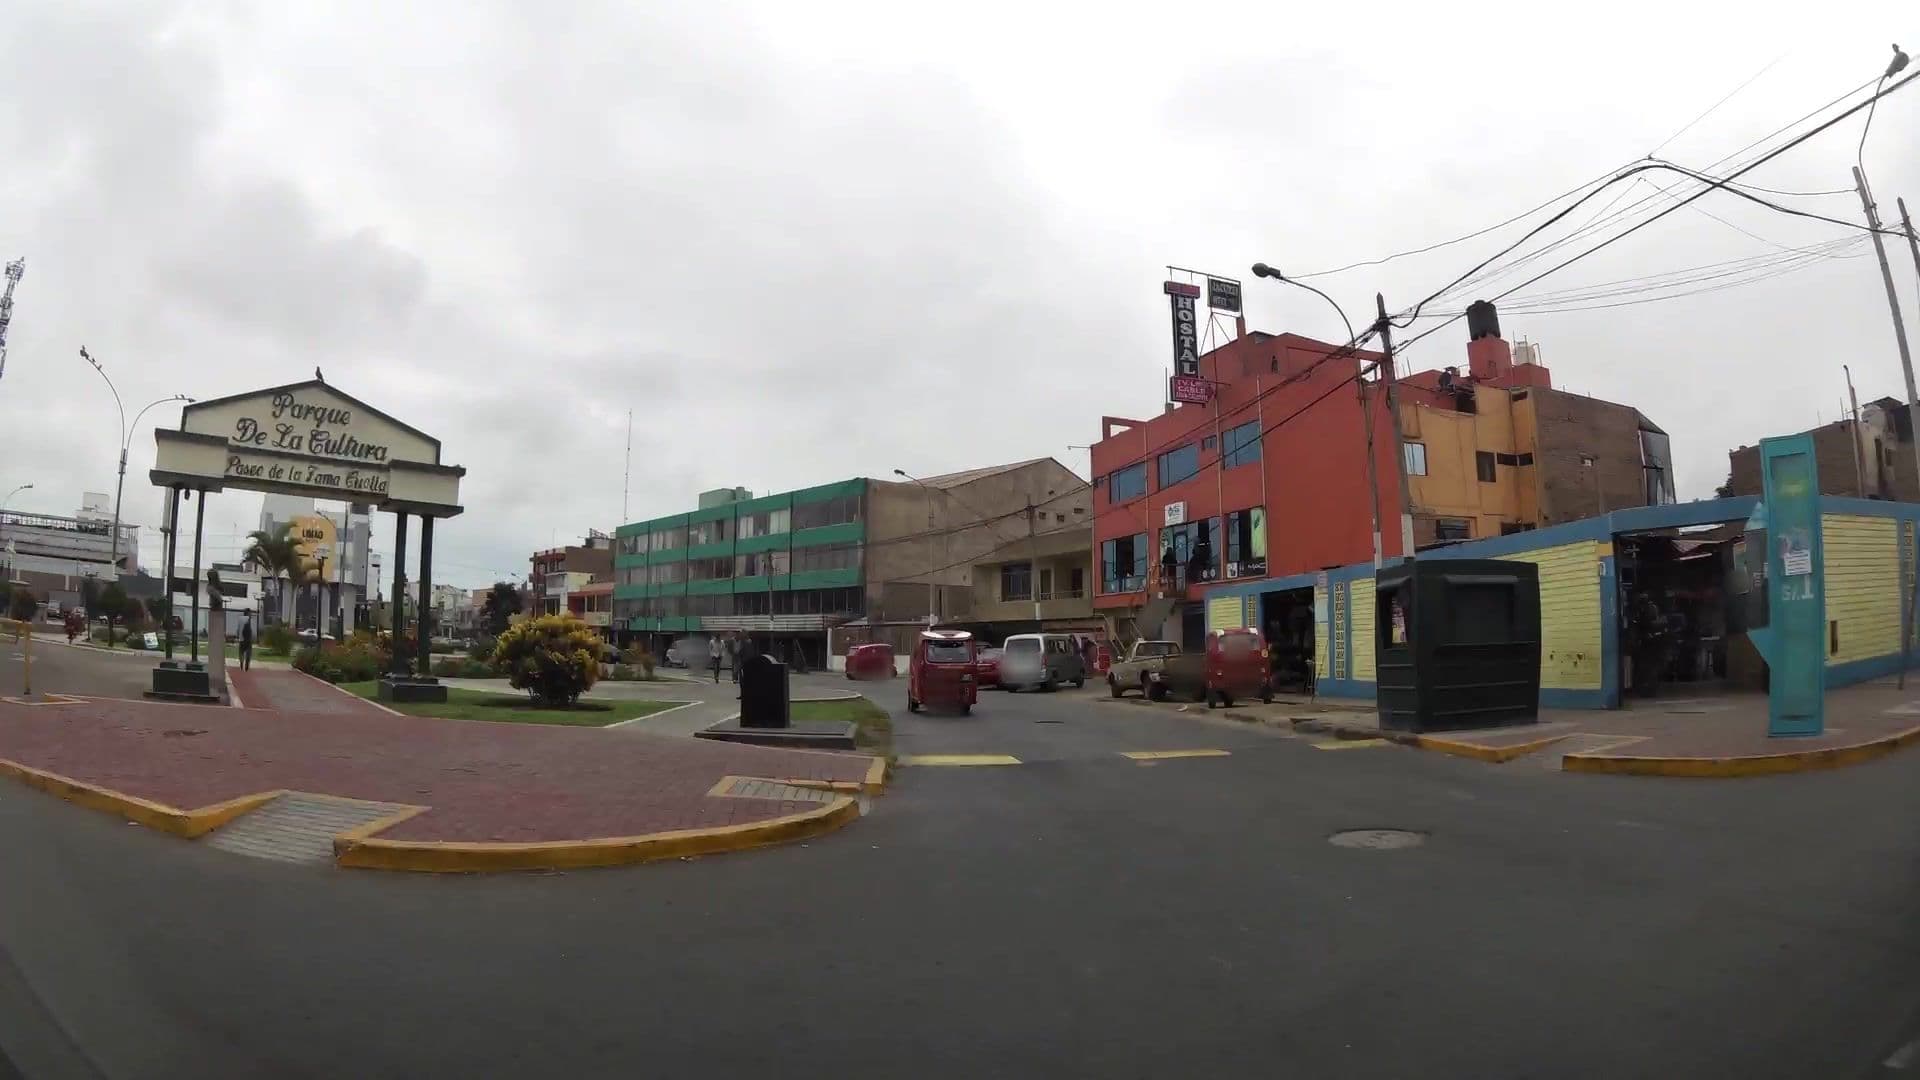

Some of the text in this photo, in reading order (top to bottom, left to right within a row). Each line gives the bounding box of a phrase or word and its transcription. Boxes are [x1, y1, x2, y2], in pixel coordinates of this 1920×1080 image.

[1176, 296, 1196, 375] HOSTAL
[271, 392, 351, 428] Parque
[232, 417, 389, 461] De La Cultura
[225, 455, 264, 477] Paseo
[268, 464, 284, 480] de
[288, 465, 302, 481] la
